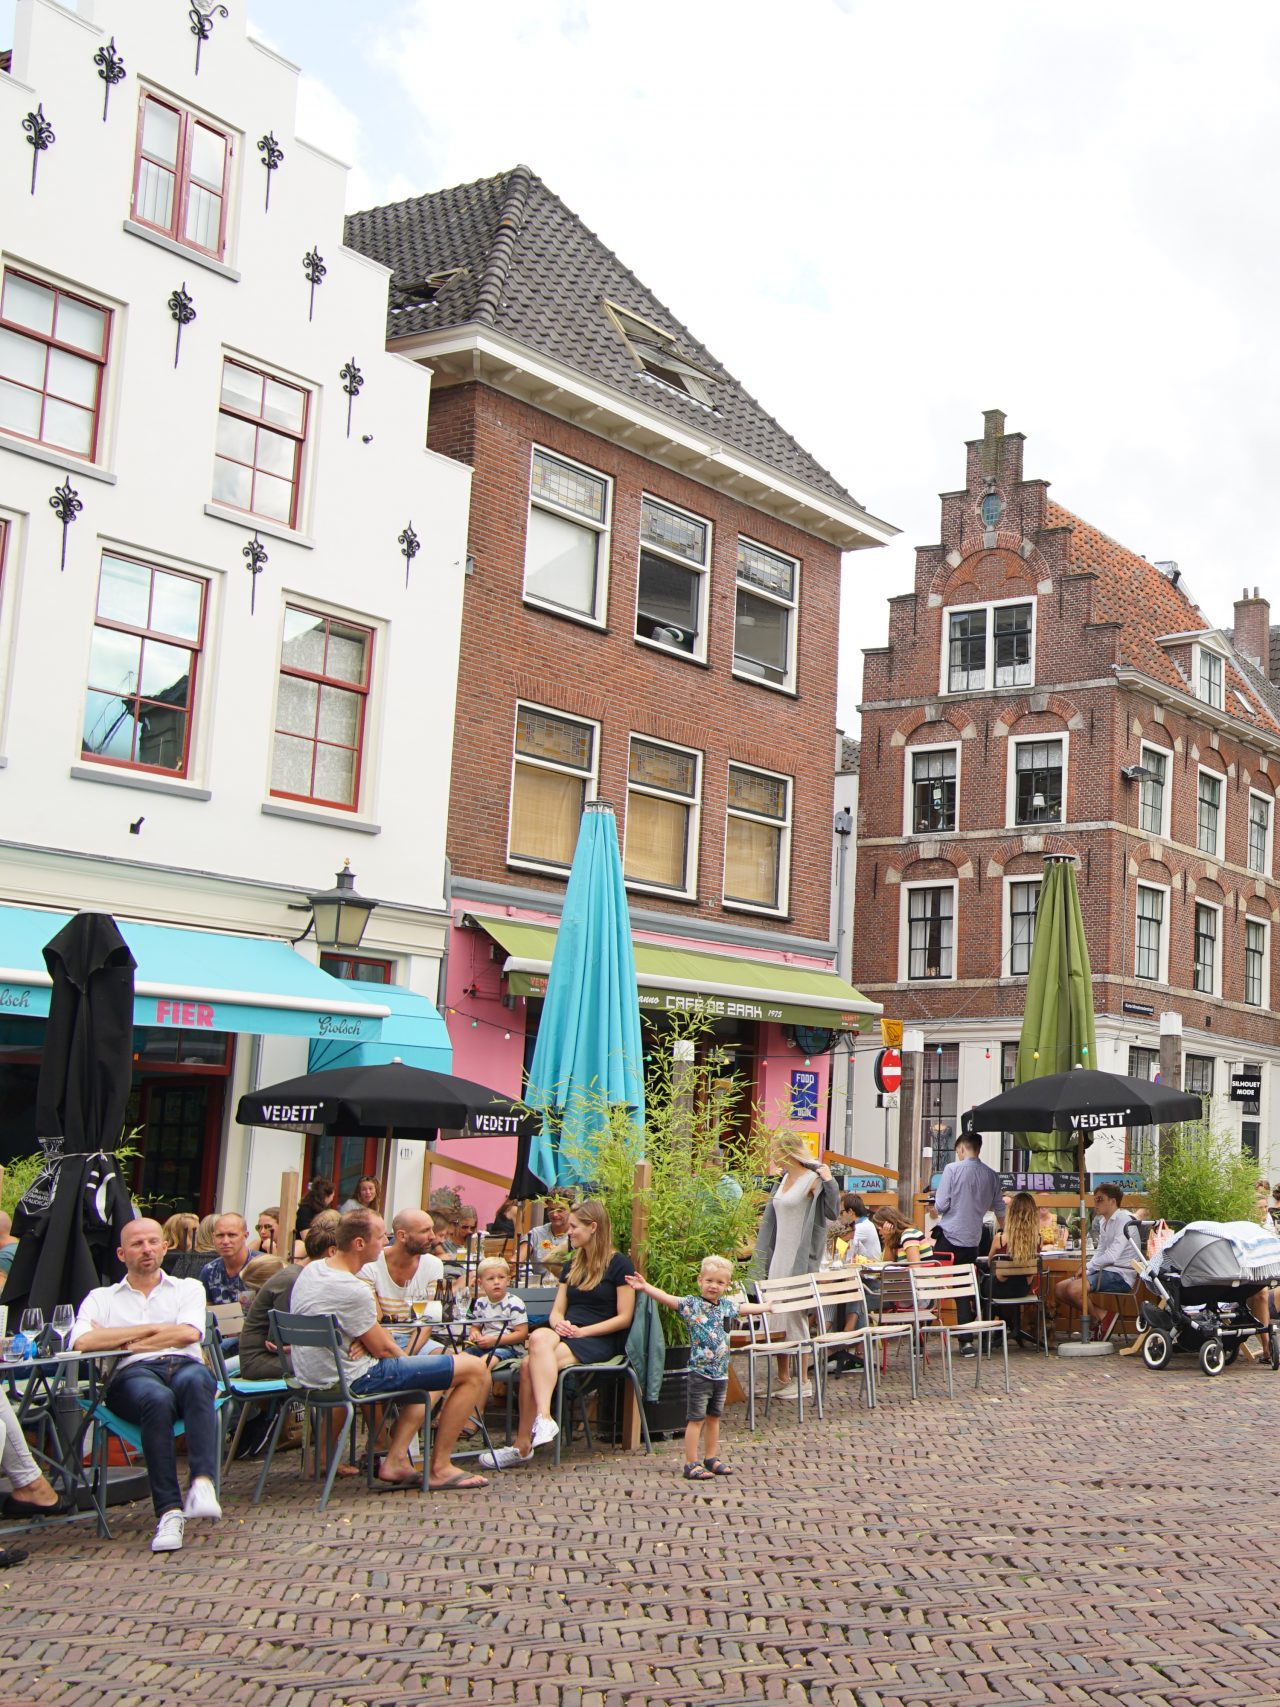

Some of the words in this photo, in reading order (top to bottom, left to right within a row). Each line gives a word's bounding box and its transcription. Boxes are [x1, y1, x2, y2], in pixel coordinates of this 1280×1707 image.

[156, 1000, 215, 1028] FIER
[767, 1009, 783, 1018] 1975
[318, 1016, 361, 1036] Grolsch
[796, 1073, 815, 1083] FOOD
[1231, 1080, 1260, 1088] SILHOUET
[1236, 1088, 1255, 1096] MODE
[262, 1105, 318, 1122] VEDETT
[1070, 1112, 1126, 1129] VEDETT
[475, 1114, 519, 1133] VEDETT
[861, 1180, 881, 1188] ZAAK
[1016, 1173, 1056, 1191] FIER
